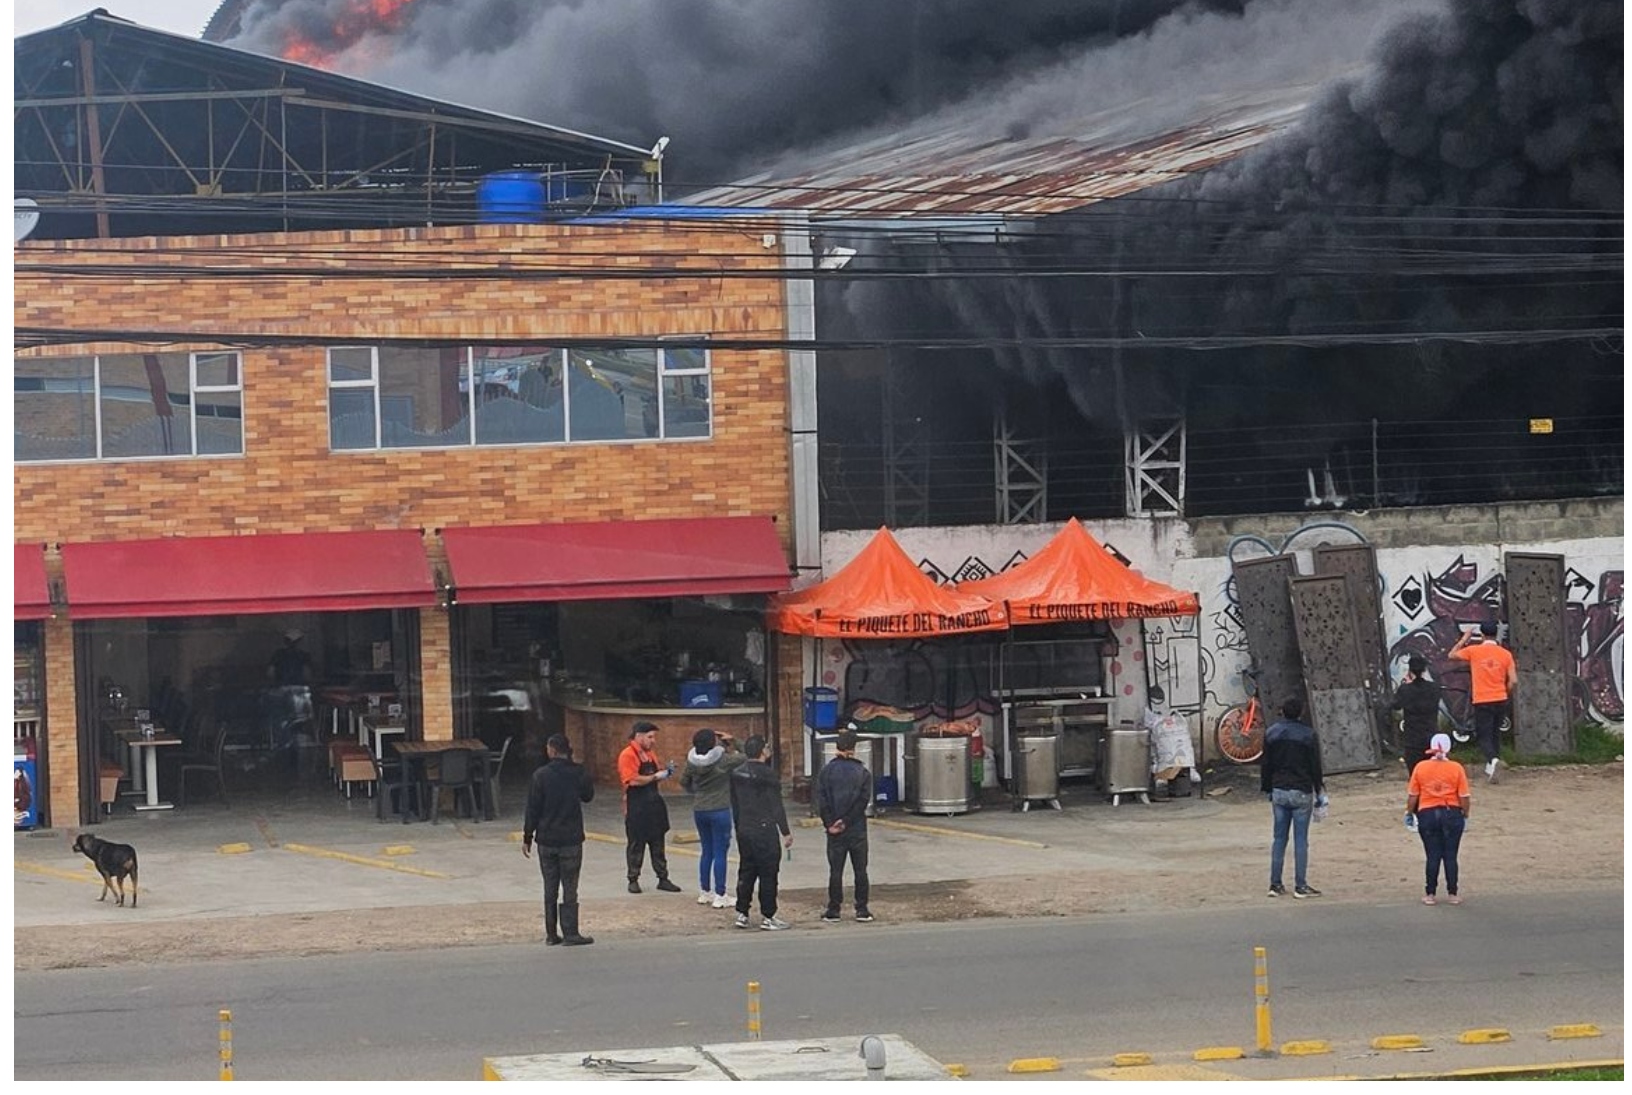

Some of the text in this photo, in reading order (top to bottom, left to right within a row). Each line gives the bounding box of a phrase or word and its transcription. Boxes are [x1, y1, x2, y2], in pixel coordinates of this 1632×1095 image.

[1029, 599, 1178, 620] EL PIQUETE DEL RANCHO
[839, 609, 991, 635] EL PIQUETE DEL RANCHO
